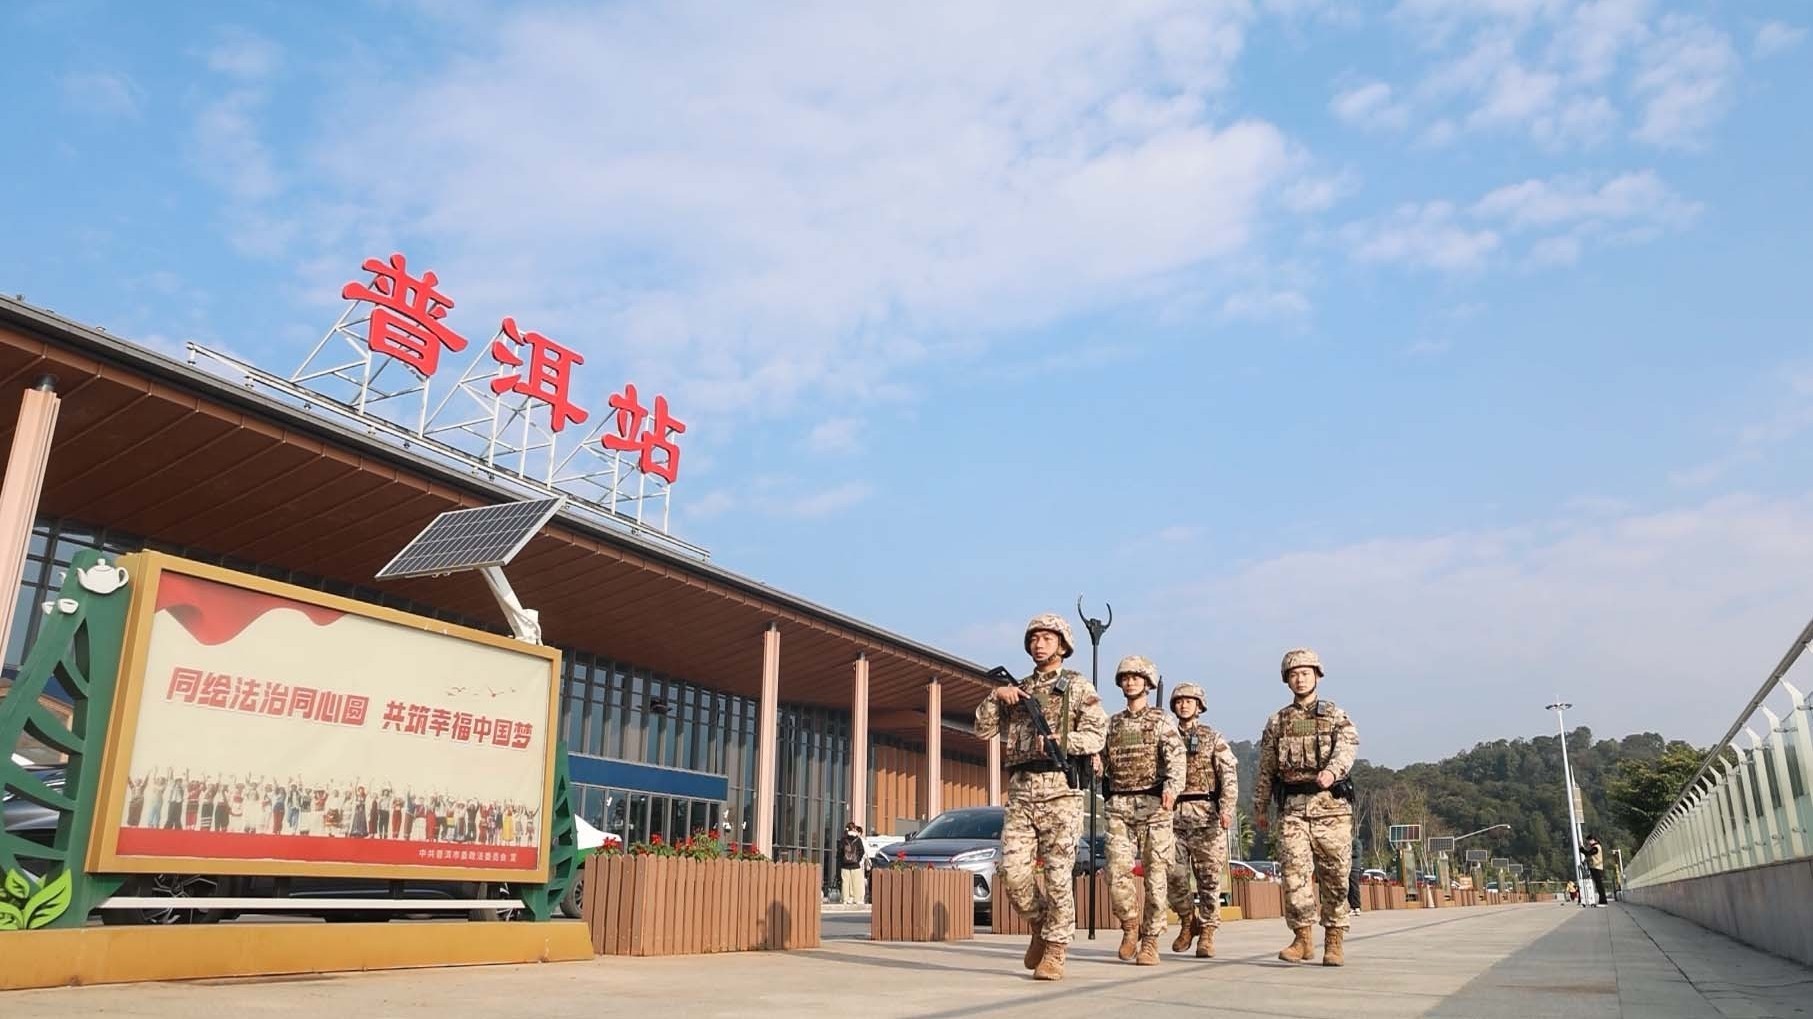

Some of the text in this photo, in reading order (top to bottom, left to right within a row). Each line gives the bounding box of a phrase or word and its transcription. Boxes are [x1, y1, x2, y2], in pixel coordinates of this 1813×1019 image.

[342, 253, 686, 484] 普洱站
[166, 666, 534, 749] 同绘法治同心圆 共筑幸福中国梦
